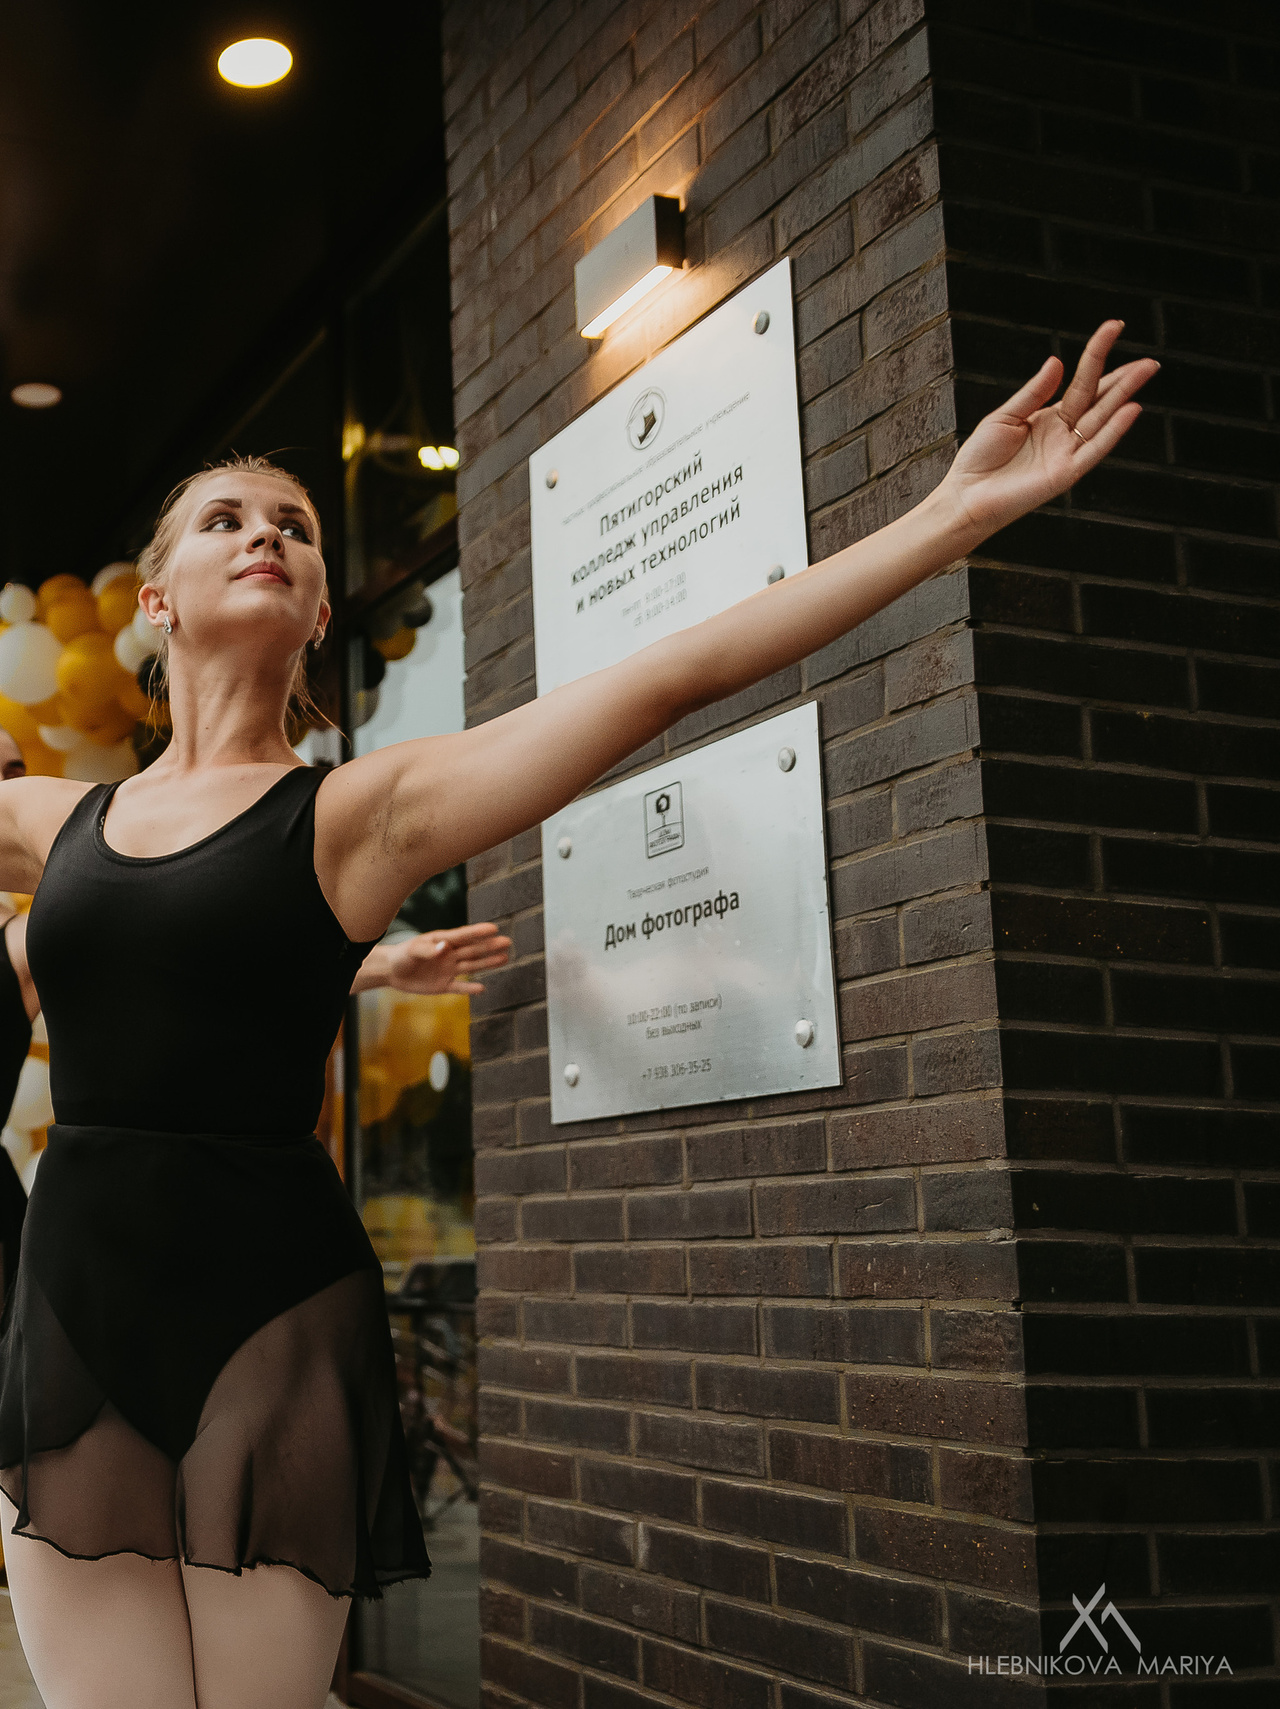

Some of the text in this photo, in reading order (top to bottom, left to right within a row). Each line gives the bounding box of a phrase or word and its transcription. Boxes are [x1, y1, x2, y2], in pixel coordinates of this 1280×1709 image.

[571, 532, 637, 586] колледж
[641, 465, 744, 546] управления
[599, 450, 703, 536] Пятигорский
[576, 495, 742, 614] и новых технологий
[604, 889, 740, 950] Дом фотографа
